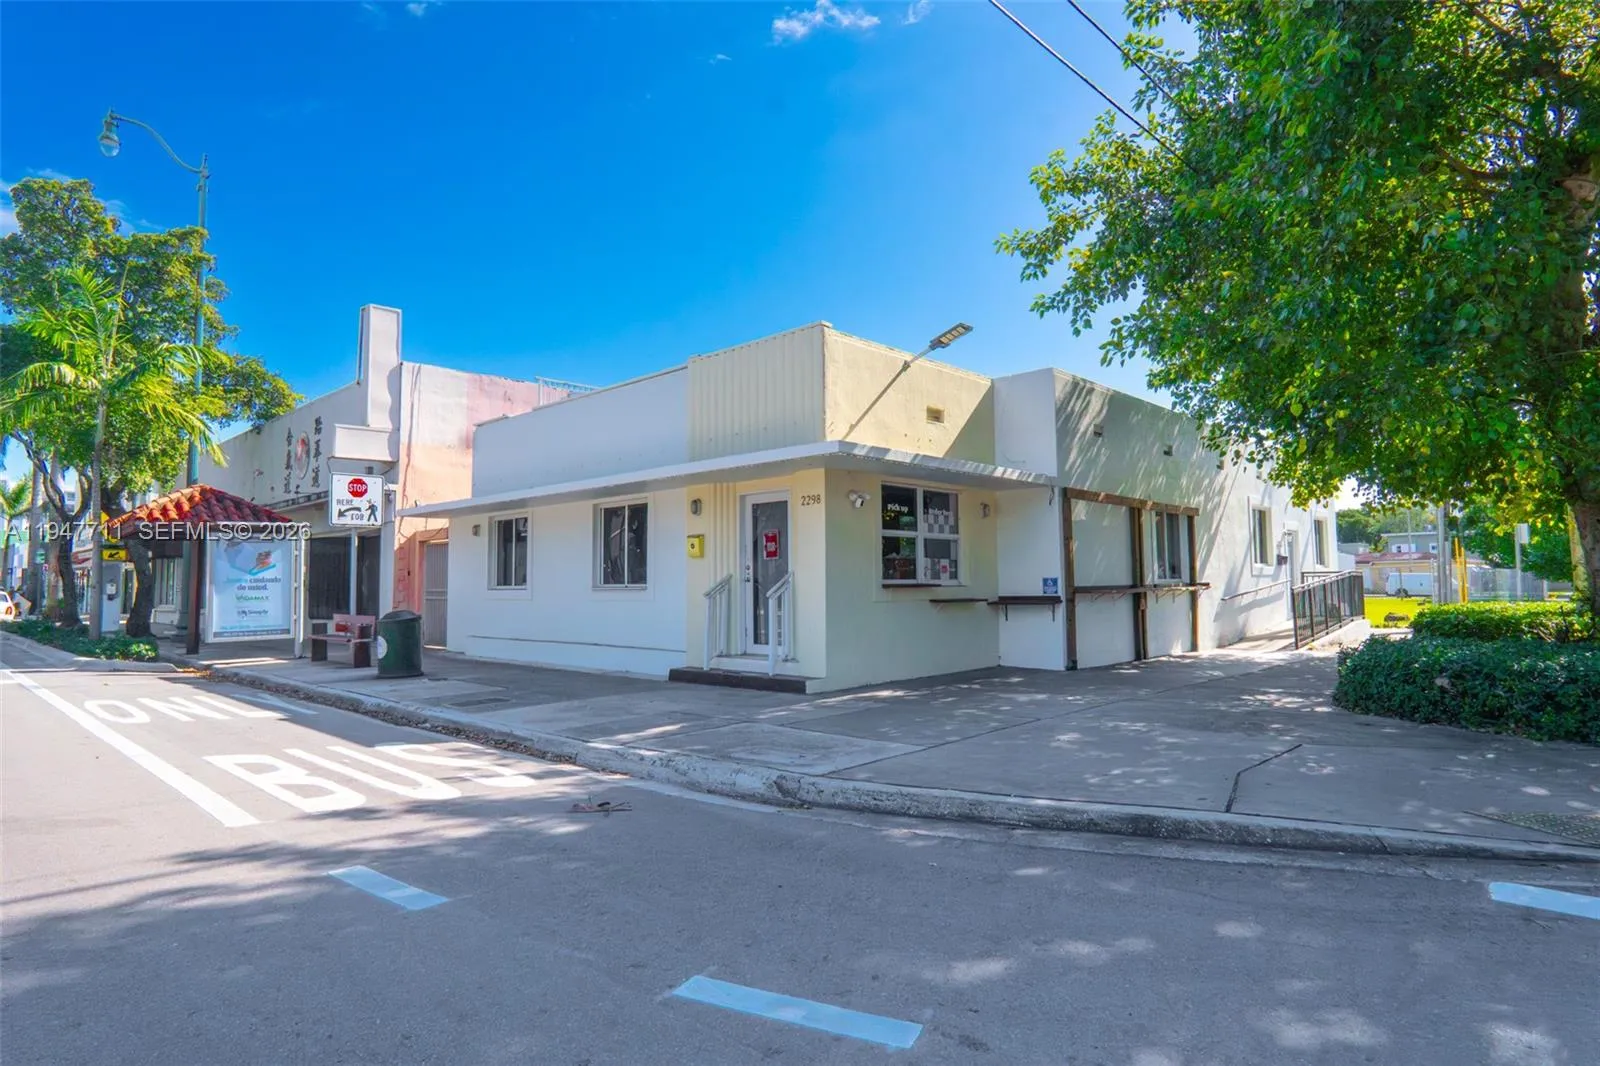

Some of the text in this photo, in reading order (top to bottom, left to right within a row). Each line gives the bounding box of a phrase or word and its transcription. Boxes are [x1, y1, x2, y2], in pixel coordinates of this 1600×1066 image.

[348, 483, 367, 493] STOP
[801, 494, 821, 506] 2298
[83, 692, 318, 725] ONLY
[200, 741, 538, 814] BUS
